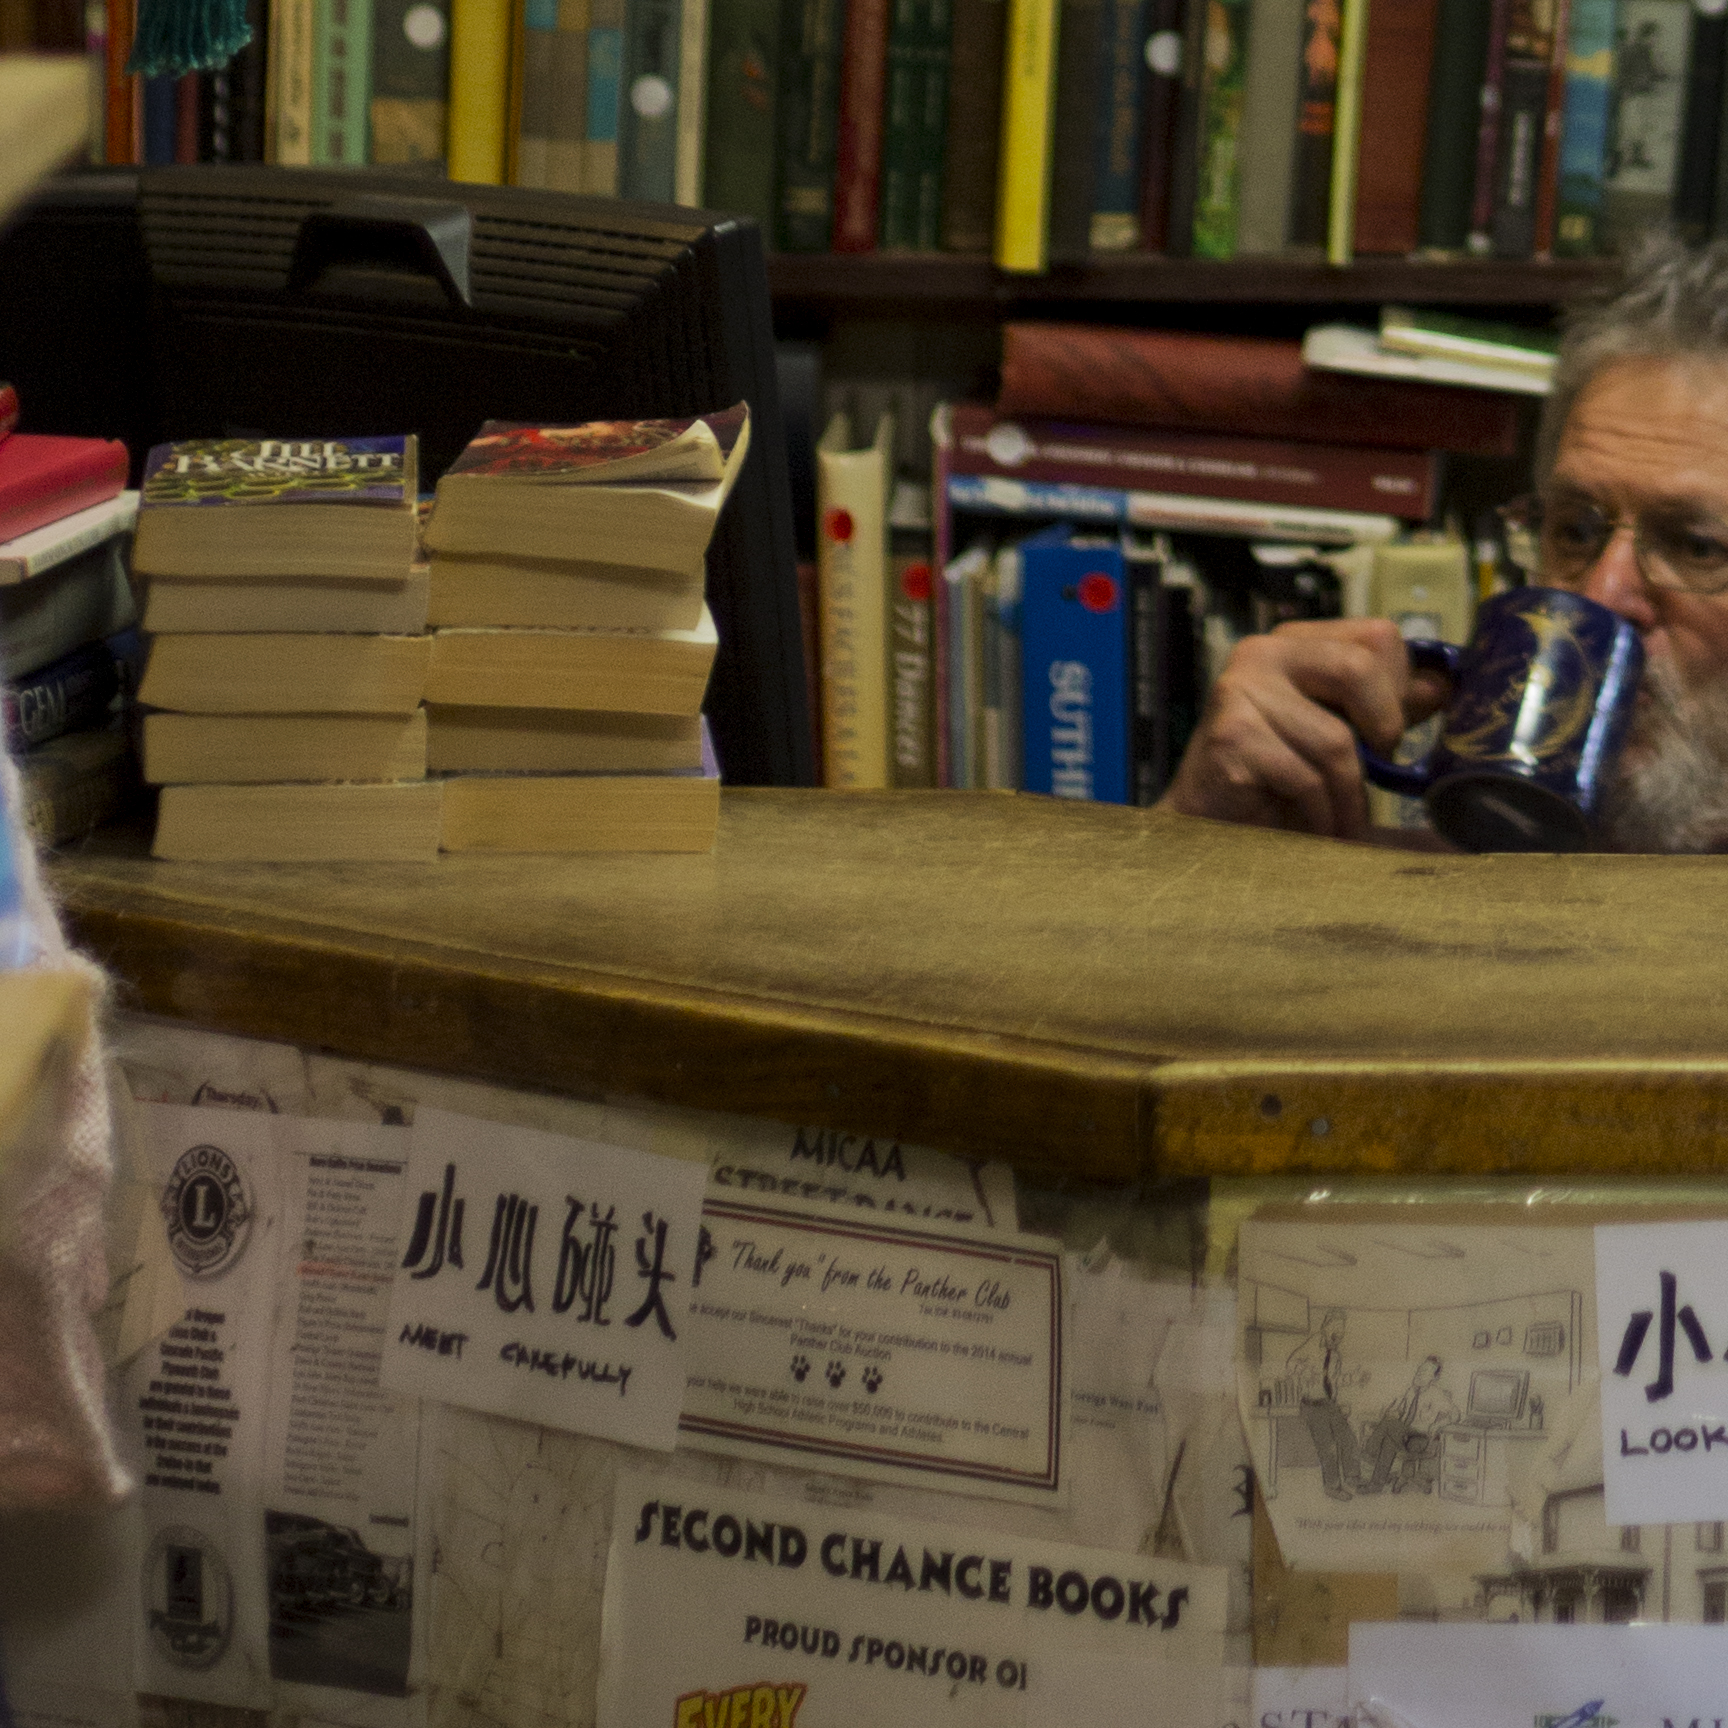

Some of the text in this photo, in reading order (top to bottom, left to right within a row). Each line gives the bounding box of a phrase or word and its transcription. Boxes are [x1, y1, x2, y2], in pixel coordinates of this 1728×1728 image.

[176, 452, 400, 475] BARNETT
[261, 440, 335, 459] JILL
[182, 1149, 234, 1182] LIONS
[820, 1257, 860, 1292] from
[866, 1260, 892, 1292] the
[899, 1268, 967, 1302] Panther
[974, 1279, 1012, 1311] Club
[828, 1339, 853, 1355] Club
[854, 1343, 892, 1361] Auction
[970, 1346, 995, 1361] 2014
[635, 1498, 1190, 1631] SECOND CHANCE BOOKS
[742, 1614, 841, 1659] PROUD
[848, 1634, 988, 1685] SPONSOR
